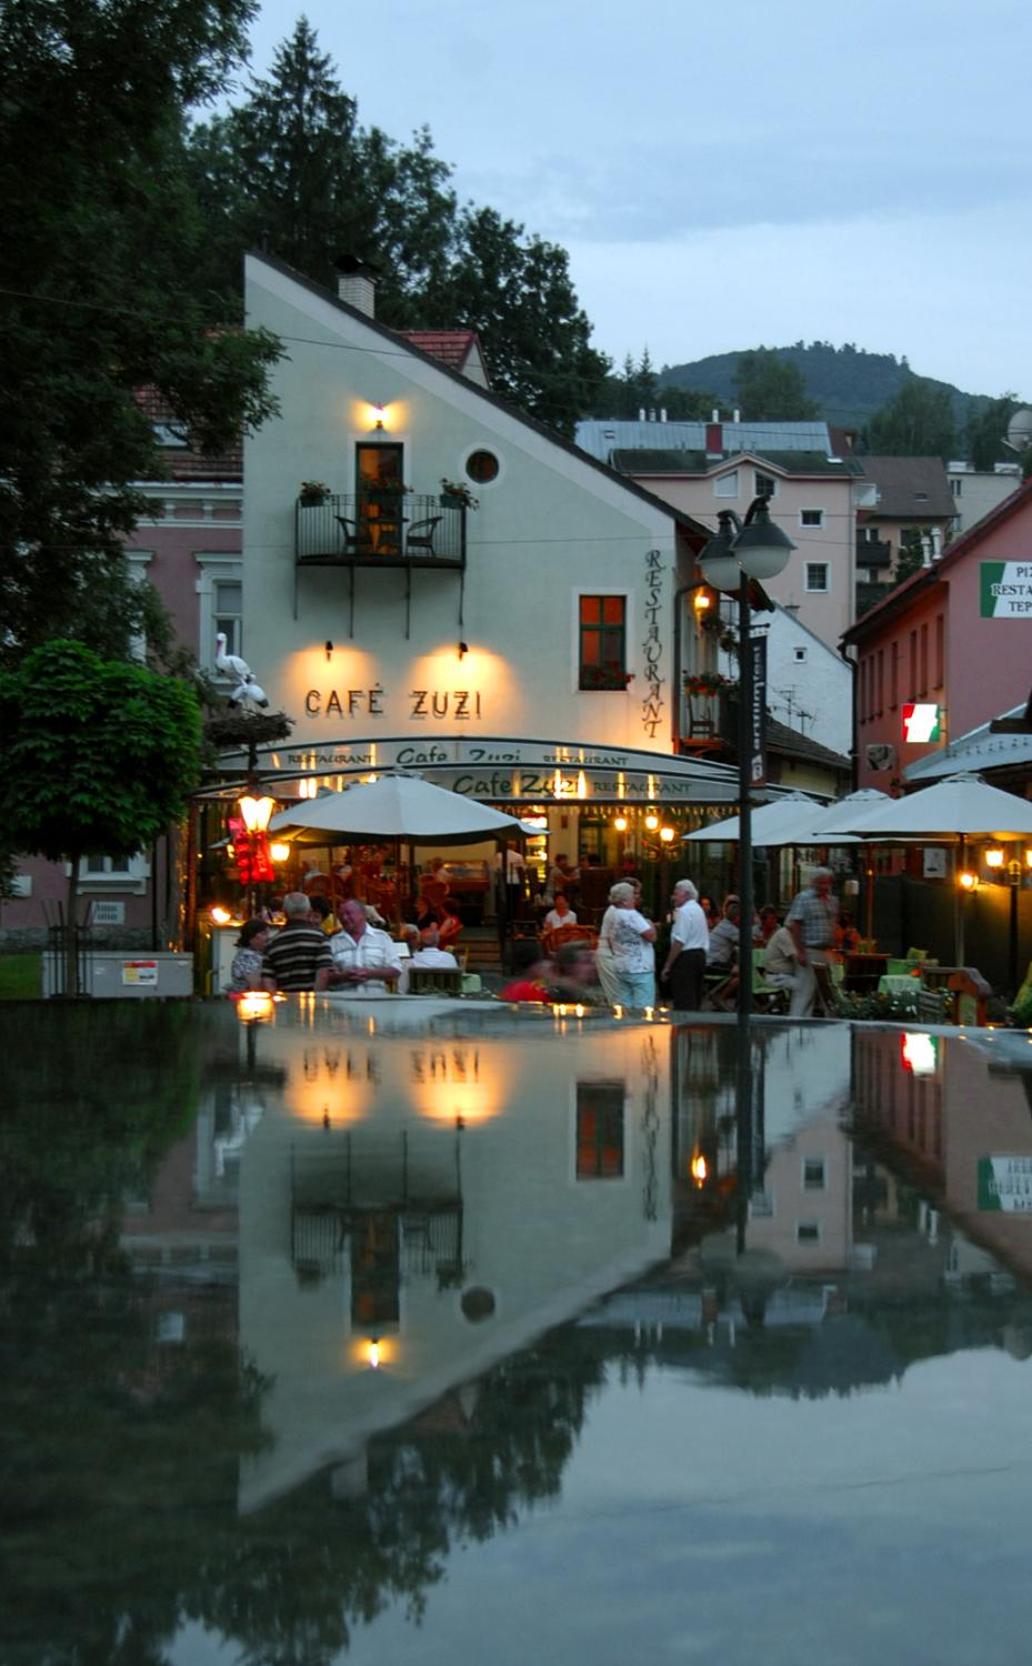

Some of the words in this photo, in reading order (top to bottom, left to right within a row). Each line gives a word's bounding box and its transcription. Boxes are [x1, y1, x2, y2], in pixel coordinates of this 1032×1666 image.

[643, 550, 667, 738] RESTAURANT
[412, 690, 481, 715] ZUZI
[288, 754, 375, 764] RESTAURANT
[453, 772, 512, 797] Cafe
